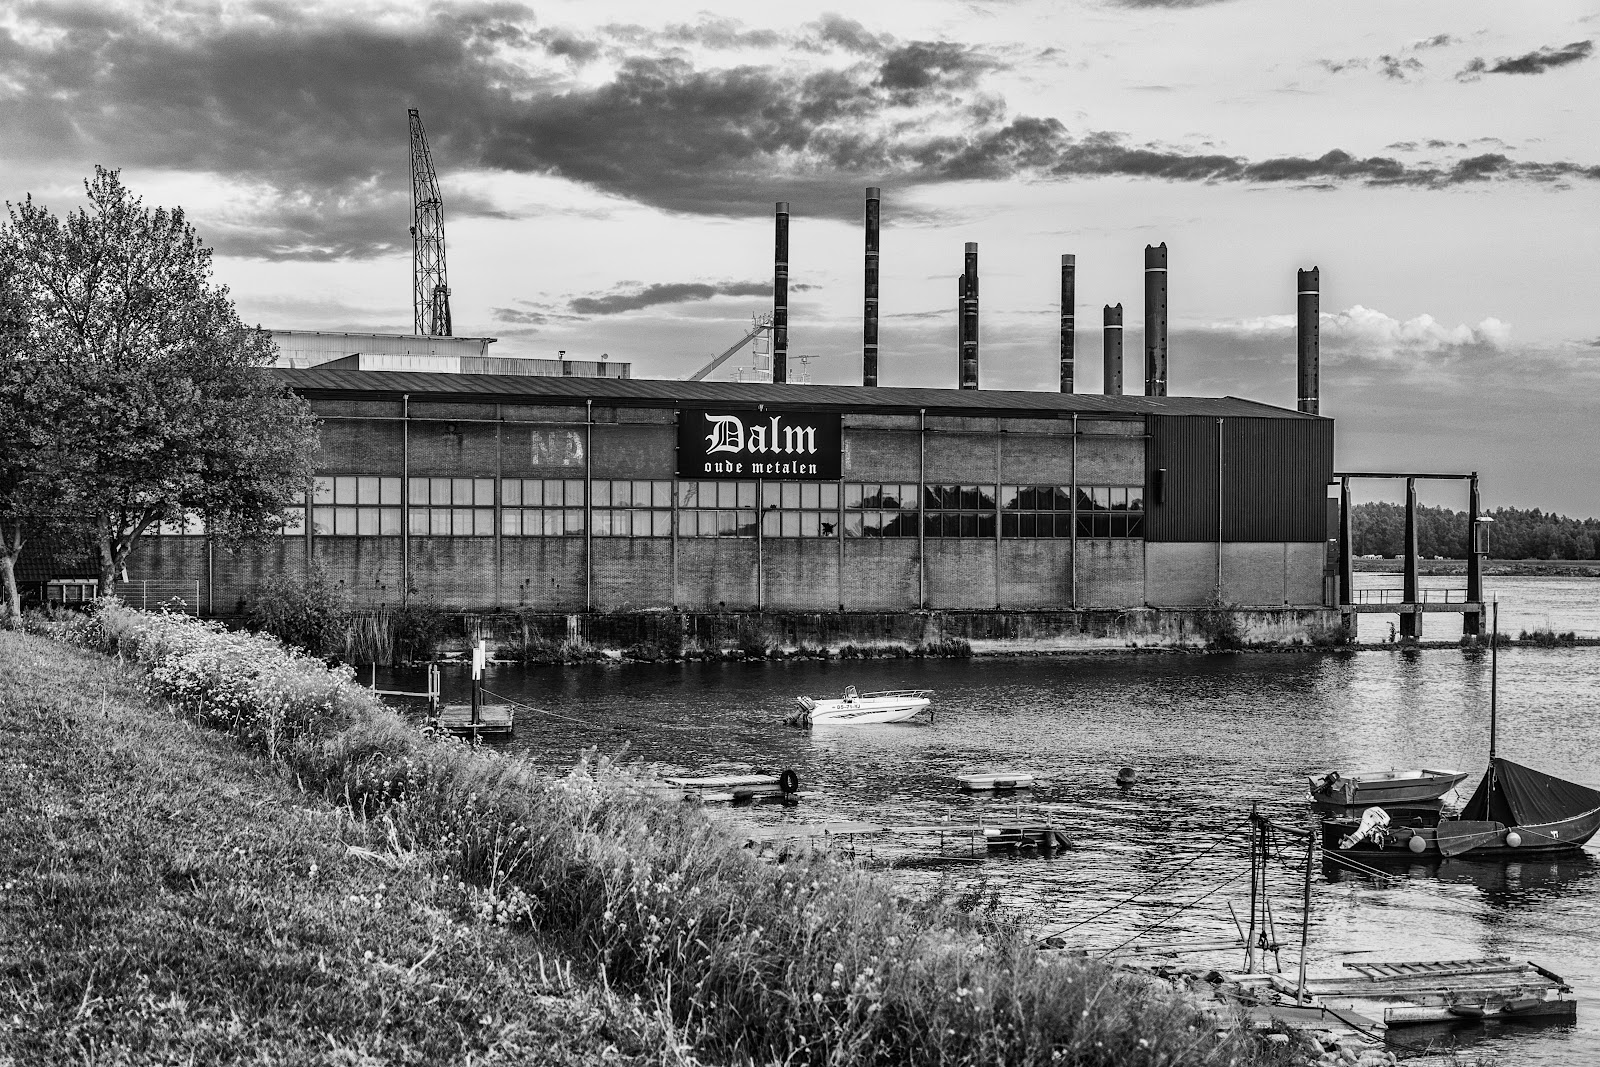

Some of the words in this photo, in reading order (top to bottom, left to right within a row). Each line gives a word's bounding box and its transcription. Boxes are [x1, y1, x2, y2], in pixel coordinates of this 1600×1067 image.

[704, 412, 818, 455] Dalm
[704, 459, 743, 473] oude
[751, 460, 818, 475] metalen
